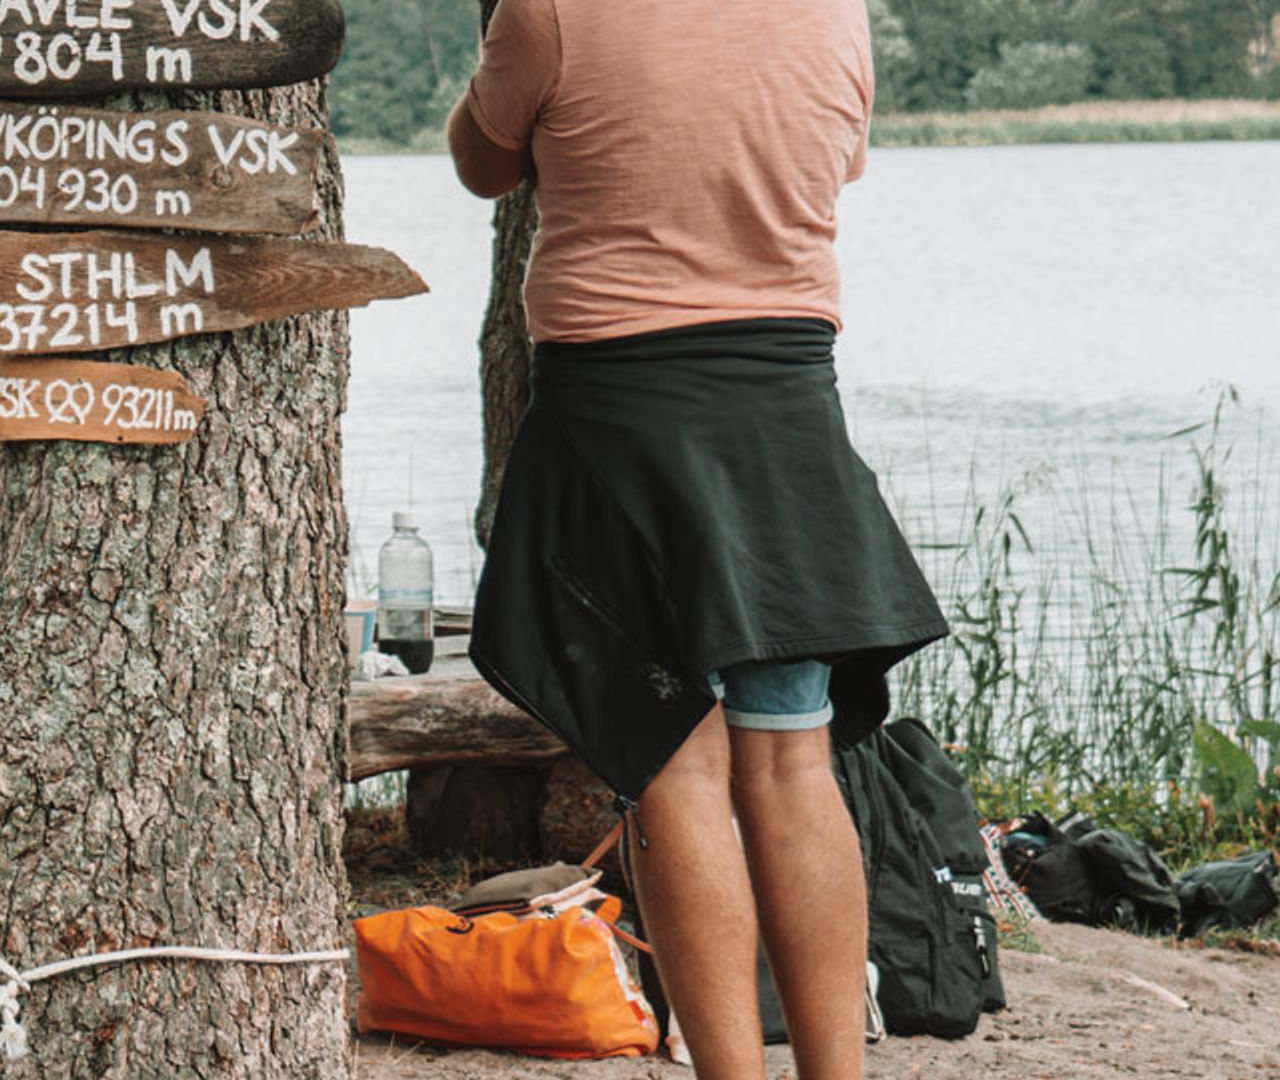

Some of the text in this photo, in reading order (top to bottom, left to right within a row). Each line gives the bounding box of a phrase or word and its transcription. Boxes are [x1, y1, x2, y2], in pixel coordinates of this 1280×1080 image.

[146, 46, 192, 82] m
[208, 124, 299, 175] VSK
[155, 189, 190, 216] m
[16, 247, 214, 301] STHLM
[160, 303, 203, 336] m
